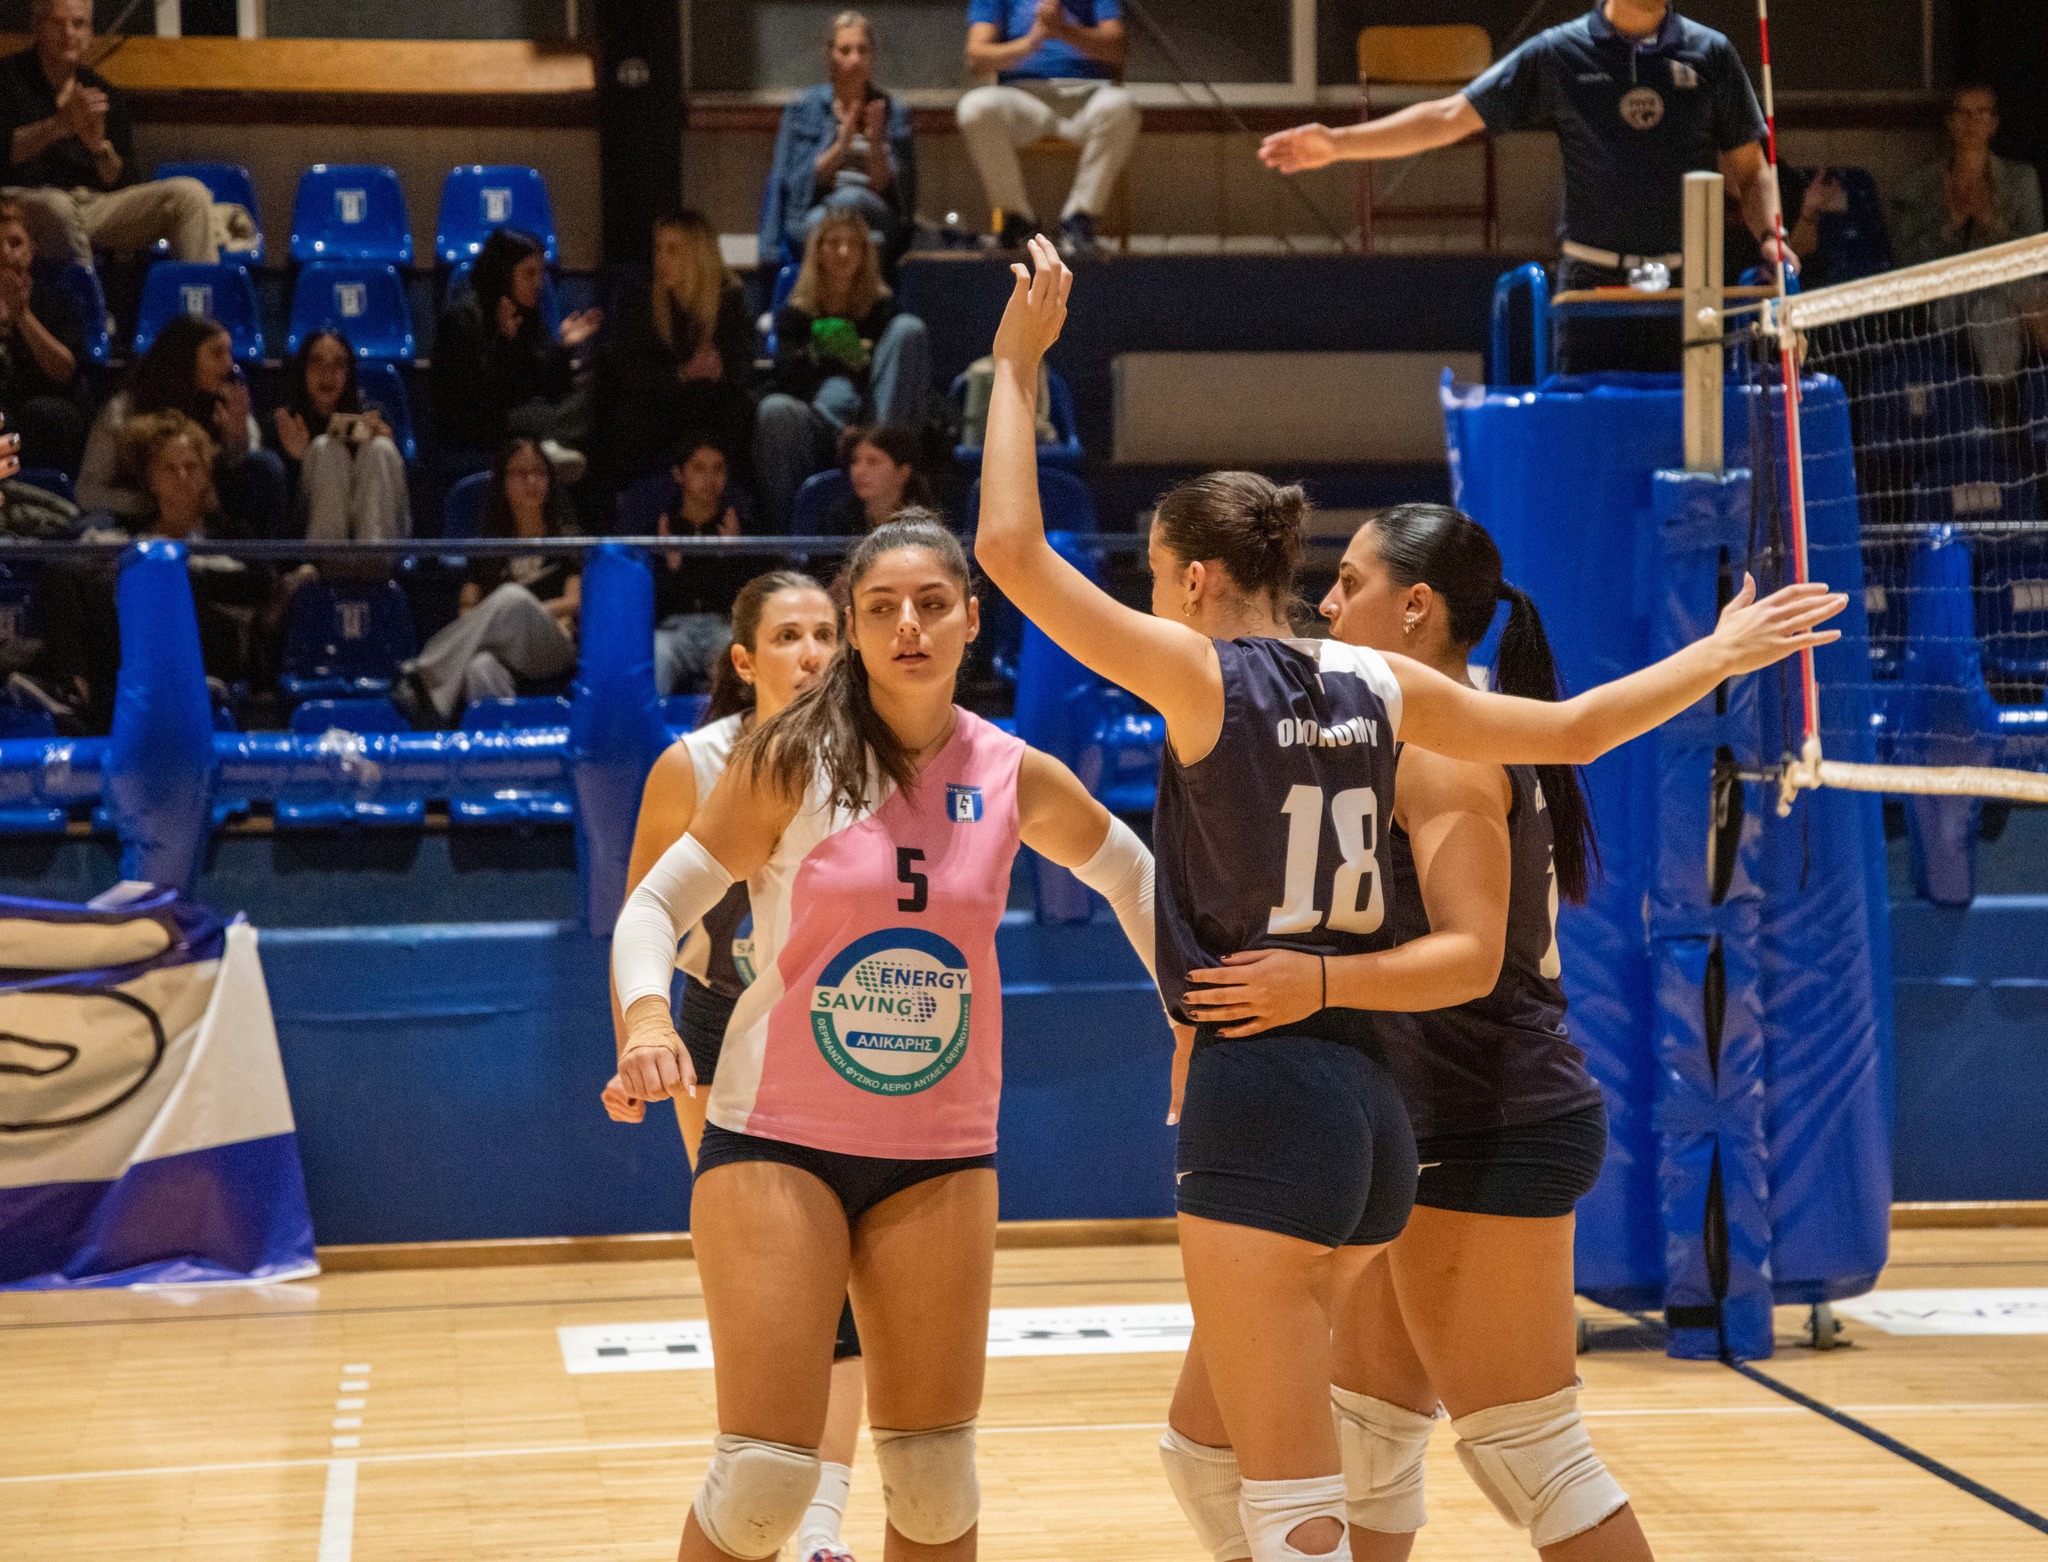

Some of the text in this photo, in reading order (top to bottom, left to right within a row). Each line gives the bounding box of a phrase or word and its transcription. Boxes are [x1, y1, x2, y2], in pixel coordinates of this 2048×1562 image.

[896, 847, 928, 912] 5
[1267, 784, 1385, 934] 18
[880, 968, 968, 989] ENERGY
[817, 991, 912, 1015] SAVING
[817, 1018, 847, 1068] ΘΕΡΜΑΝΣΗ
[845, 1066, 880, 1089] ΦΥΣΙΚΟ
[881, 1083, 912, 1092] ΑΕΡΙΟ
[856, 1035, 933, 1051] ΑΛΙΚΑΡΗΣ
